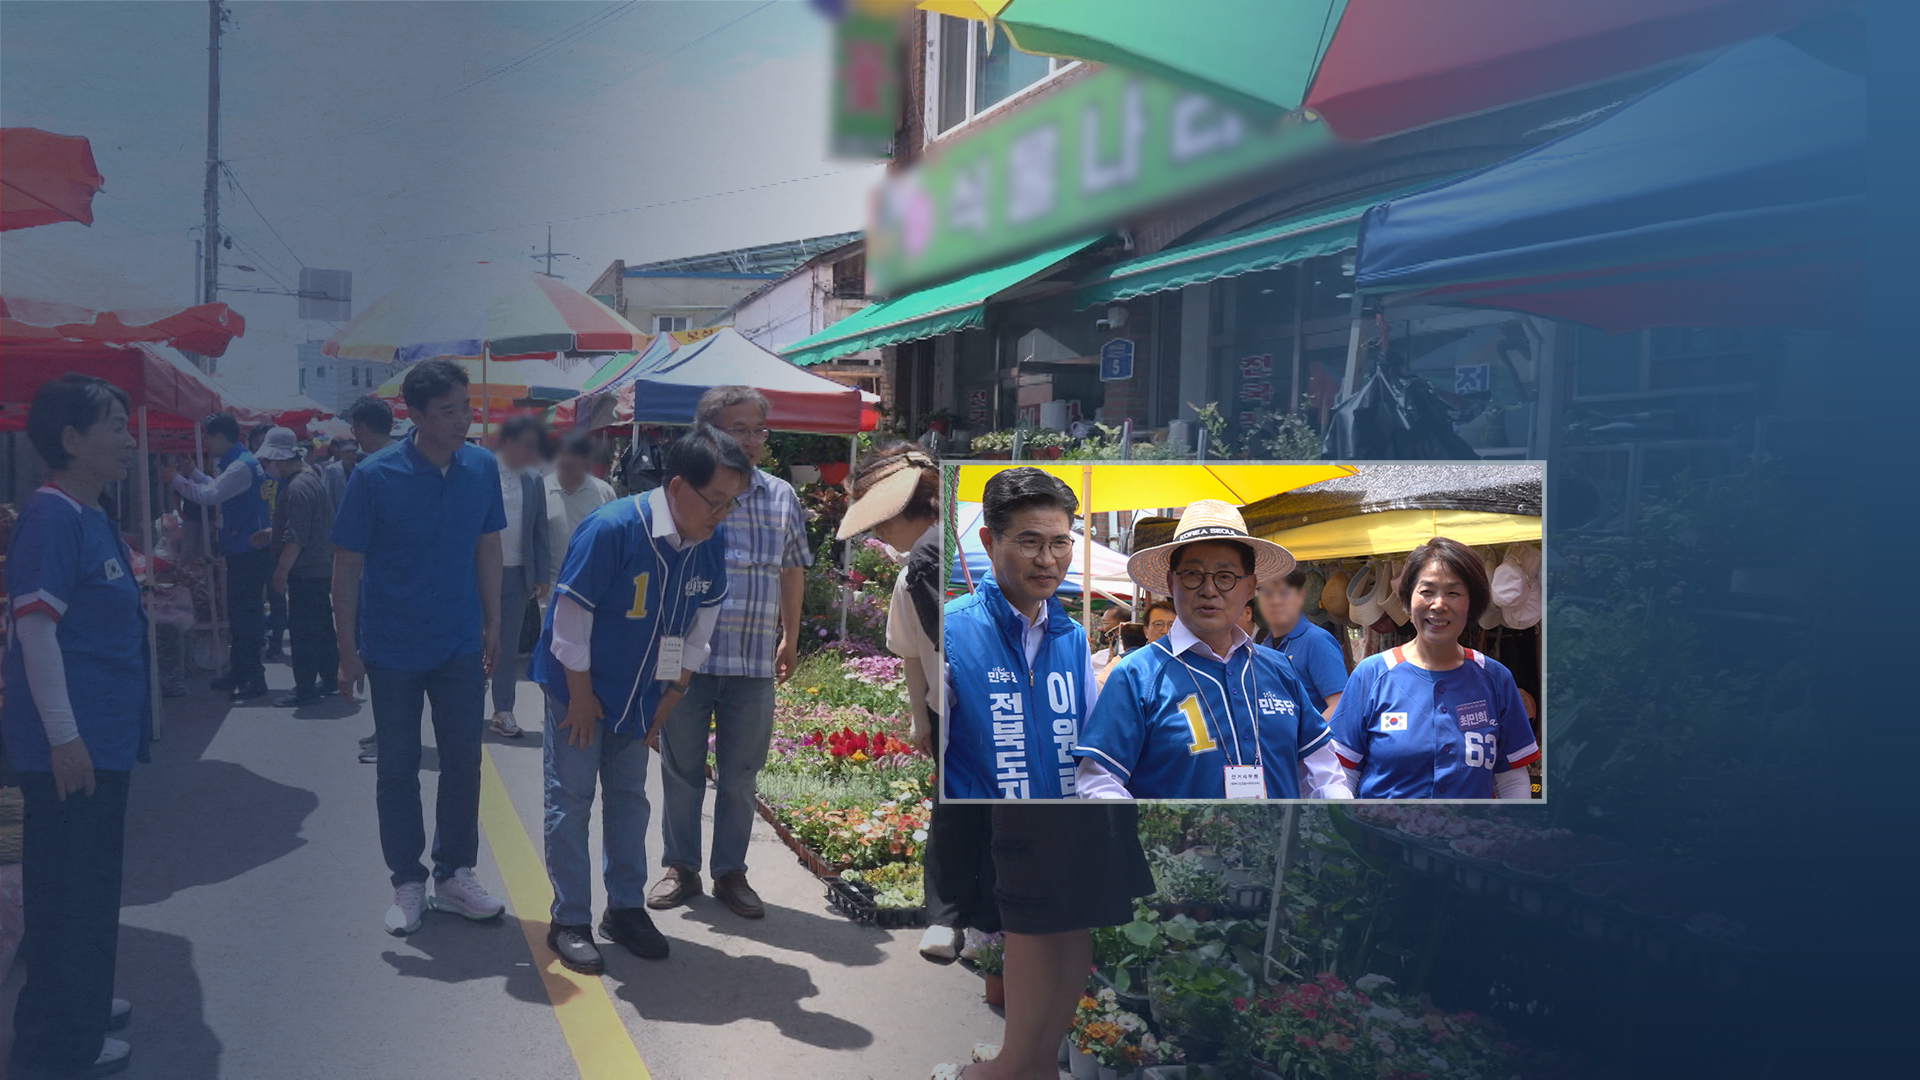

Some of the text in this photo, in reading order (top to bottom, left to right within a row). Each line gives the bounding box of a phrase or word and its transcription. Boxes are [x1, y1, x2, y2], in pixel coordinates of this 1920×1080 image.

[1112, 359, 1120, 376] 5
[1180, 527, 1238, 540] KOREA SEOUL
[625, 571, 650, 619] 1
[1258, 698, 1295, 716] 민주당
[1176, 692, 1218, 756] 1
[1459, 710, 1489, 727] 최민희
[1464, 731, 1497, 770] 63
